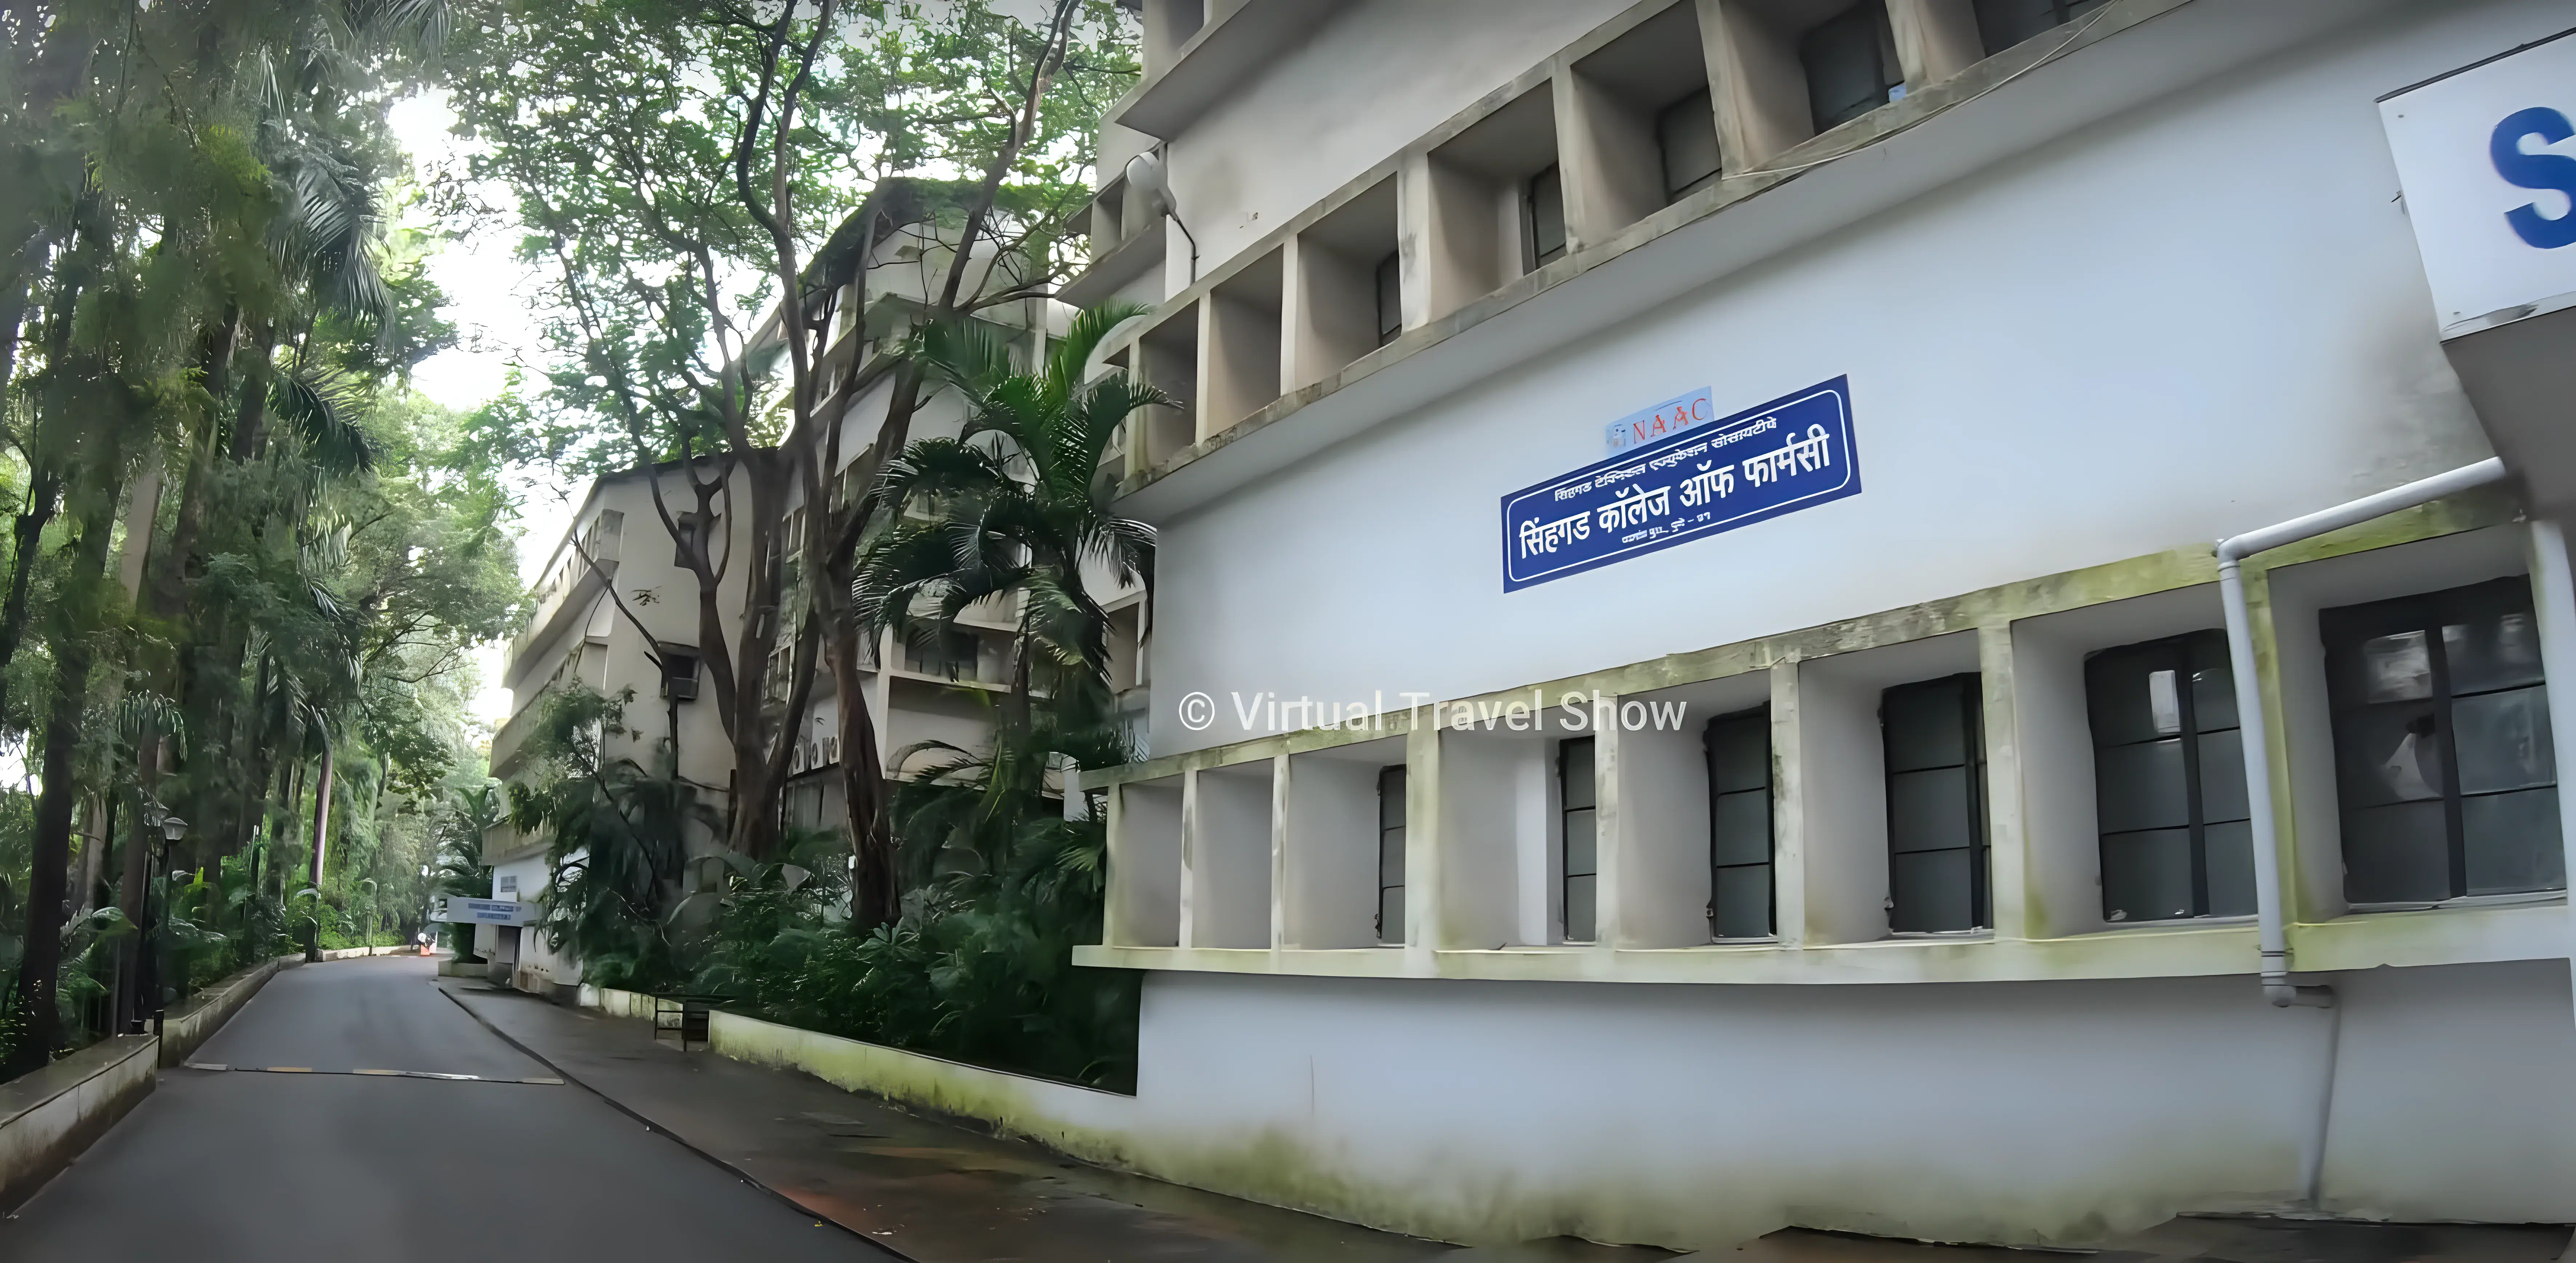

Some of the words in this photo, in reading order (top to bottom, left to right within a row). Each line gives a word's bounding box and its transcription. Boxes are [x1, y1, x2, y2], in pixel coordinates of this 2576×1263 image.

[2490, 107, 2576, 249] S
[1633, 398, 1710, 444] NAAC
[1519, 511, 1590, 559] सिंहगड
[1597, 483, 1671, 533] कॉलेज
[1679, 460, 1734, 507] ऑफ
[1742, 424, 1829, 487] फार्मसी
